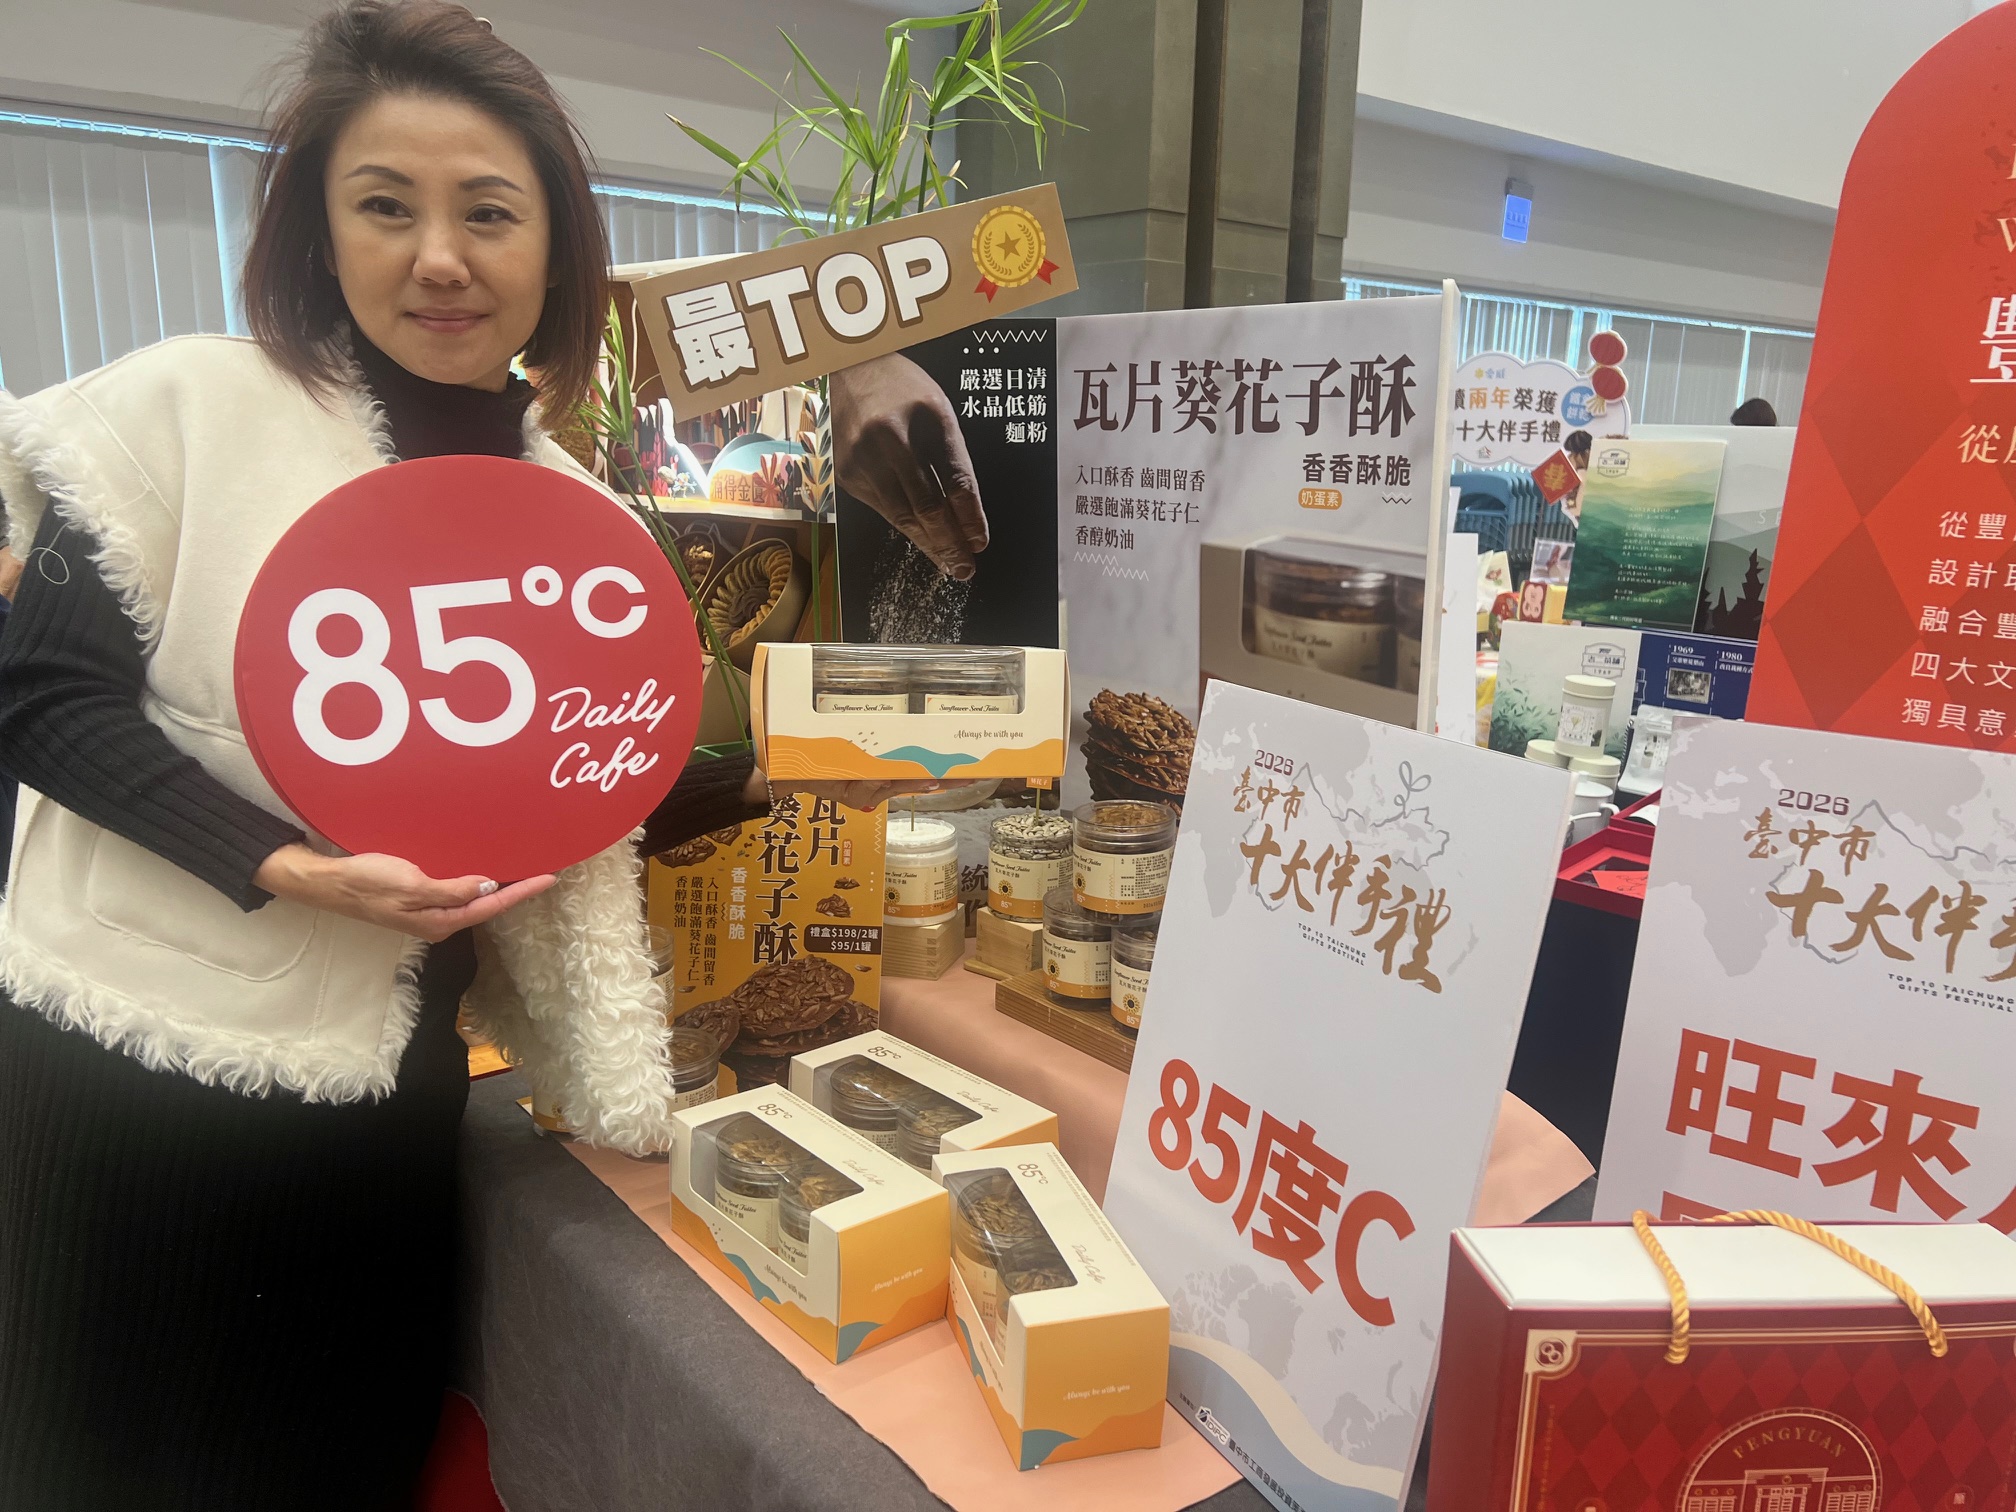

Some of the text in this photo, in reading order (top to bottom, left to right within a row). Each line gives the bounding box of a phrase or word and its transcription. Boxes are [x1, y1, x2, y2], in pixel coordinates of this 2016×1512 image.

[665, 235, 951, 387] 最TOP
[960, 367, 1047, 391] 嚴選日清
[960, 394, 1047, 418] 水晶低筋
[1073, 354, 1416, 437] 瓦片葵花子酥
[1005, 421, 1048, 443] 麵粉
[1456, 419, 1561, 443] 十大伴手禮
[1075, 464, 1206, 492] 入口酥香 齒間留香
[1302, 453, 1412, 486] 香香酥脆
[1075, 495, 1200, 524] 嚴選飽滿葵花子仁
[1300, 490, 1340, 507] 奶蛋素
[1075, 525, 1135, 550] 香醇奶油
[1939, 511, 2016, 540] 從豐
[288, 565, 648, 765] 85°C
[1721, 651, 1743, 661] 1980
[1911, 652, 2016, 689] 四大文
[548, 678, 675, 733] Daily
[939, 704, 969, 712] Sunflower
[1902, 698, 2016, 737] 獨具意
[954, 729, 1023, 740] Always be with you
[549, 736, 659, 792] Cafe
[1254, 749, 1295, 776] 2026
[1233, 766, 1305, 831] 臺中市
[1777, 788, 1850, 816] 2026
[1744, 807, 1876, 877] 臺中市
[674, 876, 688, 928] 香醇奶油
[728, 867, 748, 940] 香香酥脆
[1239, 824, 1452, 994] 十大伴手禮
[687, 877, 703, 982] 嚴選飽滿葵花子仁
[703, 877, 719, 986] 入口酥香 齒間留香
[1302, 932, 1364, 966] GIFTS FESTIVAL
[1327, 935, 1366, 958] TAICHUNG
[1888, 973, 2015, 1005] TOP 10 TAICHUNG
[1898, 983, 2014, 1013] GIFTS FESTIVAL
[1665, 1028, 2016, 1236] 旺來
[1148, 1058, 1416, 1327] 85度C
[1731, 1427, 1847, 1459] FENGYUAN
